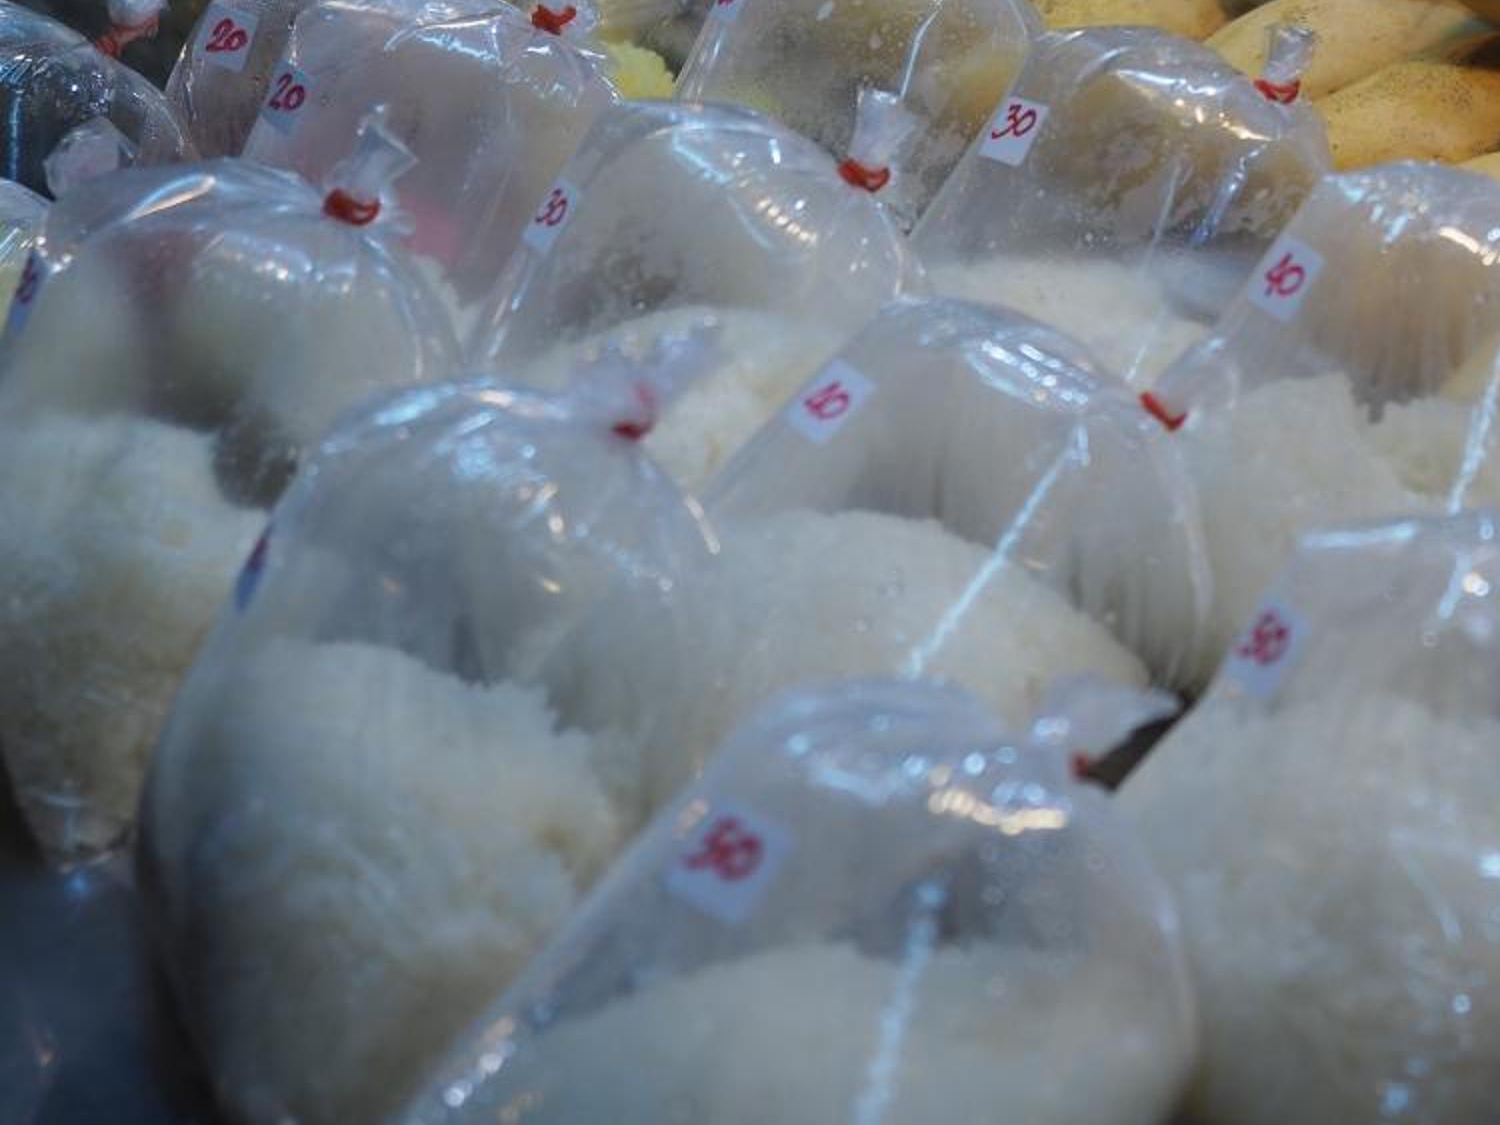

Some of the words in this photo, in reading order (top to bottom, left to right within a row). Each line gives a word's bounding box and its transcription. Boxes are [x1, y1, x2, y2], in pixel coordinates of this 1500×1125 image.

[205, 18, 248, 52] 20
[269, 73, 305, 109] 20
[991, 104, 1036, 139] 30
